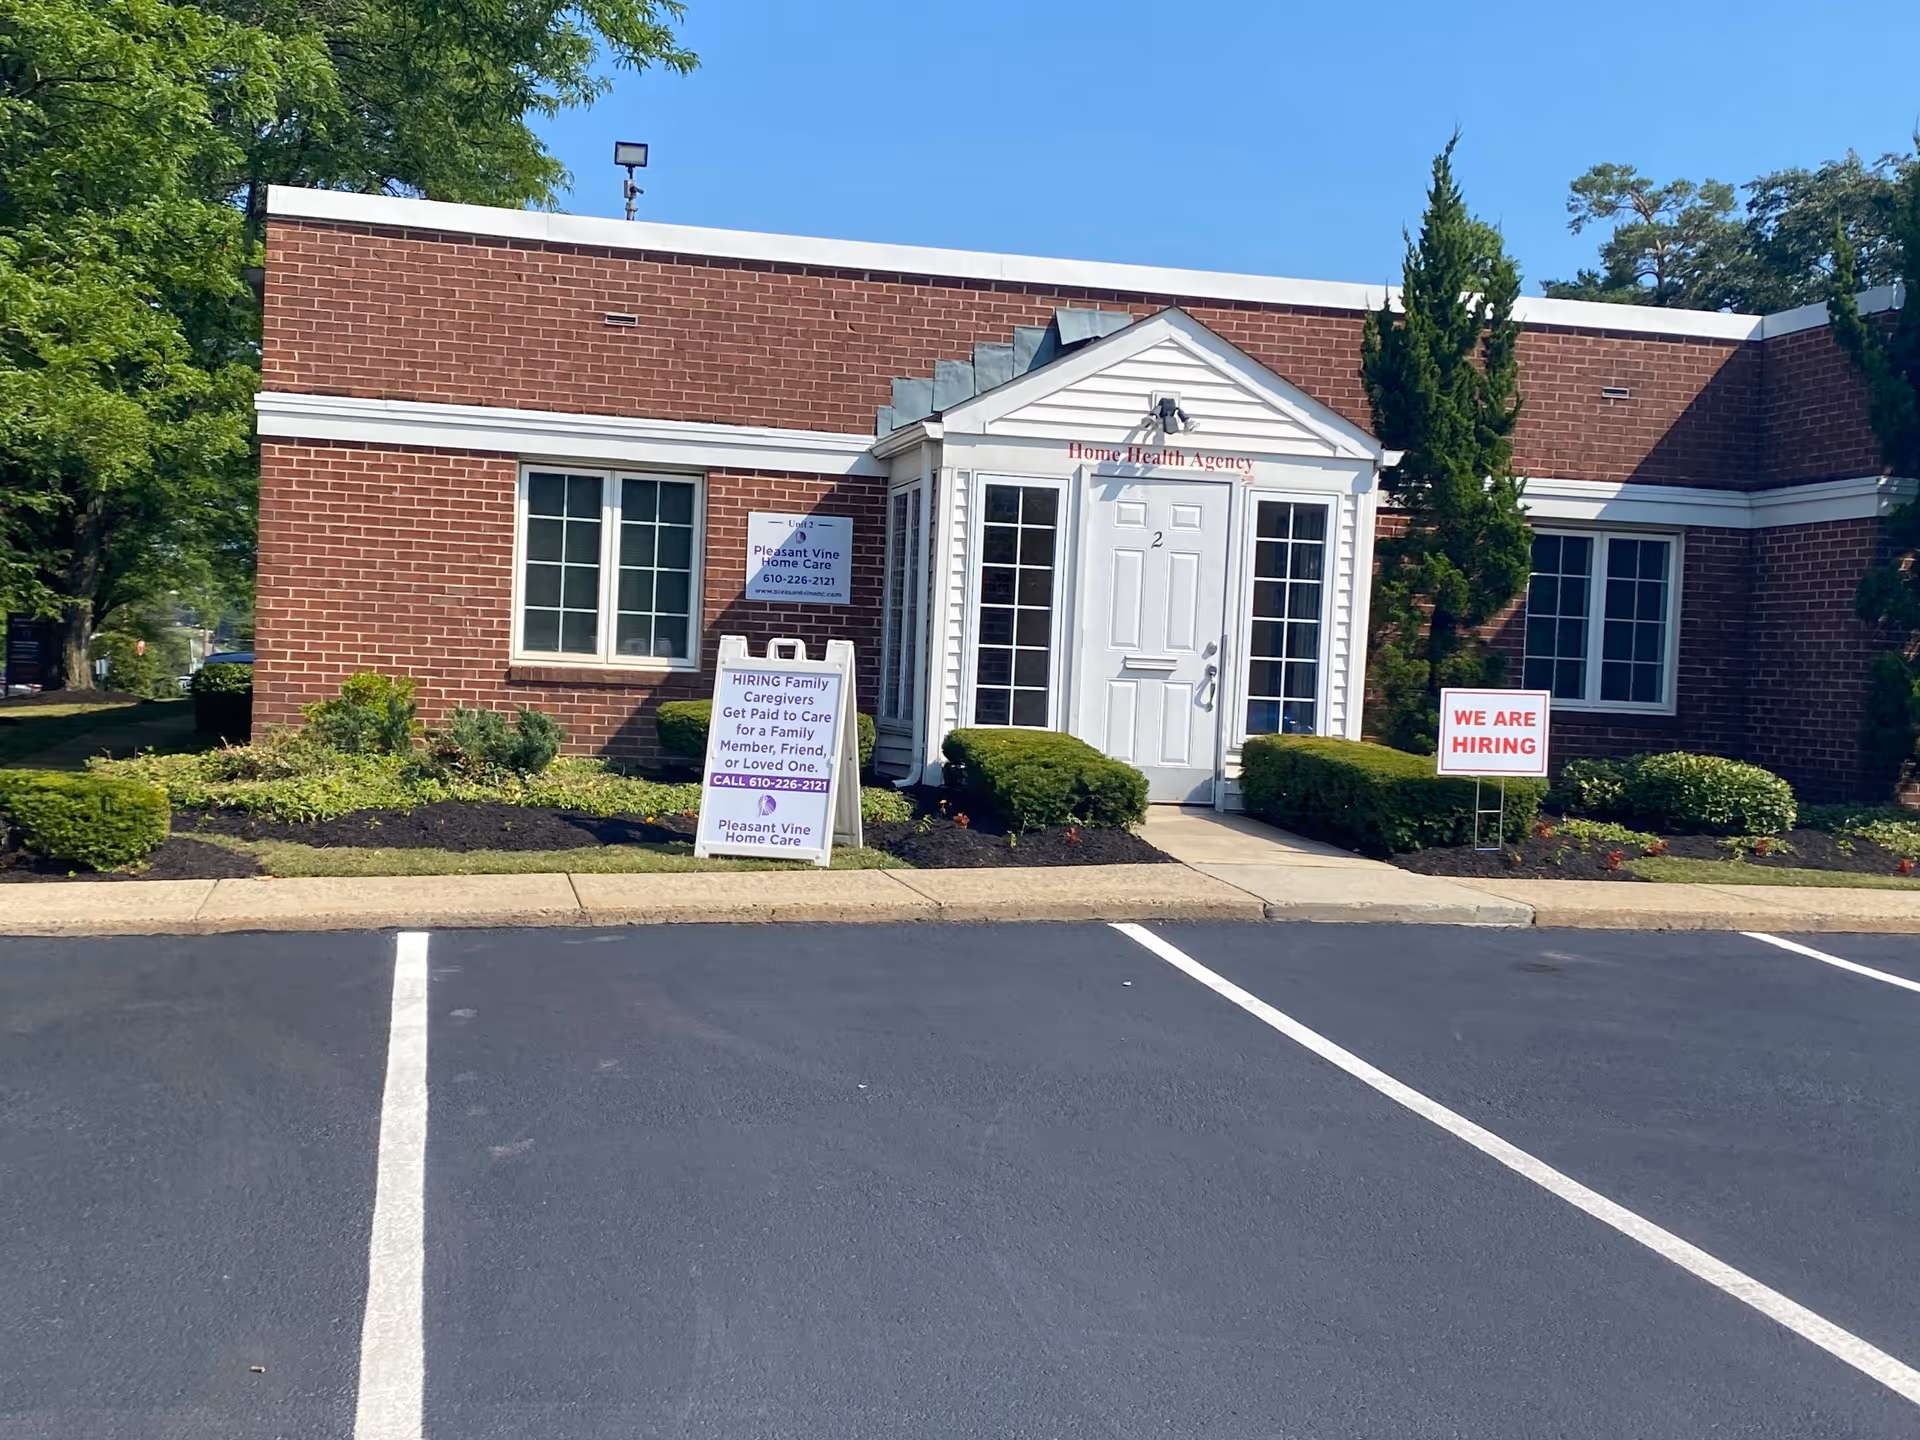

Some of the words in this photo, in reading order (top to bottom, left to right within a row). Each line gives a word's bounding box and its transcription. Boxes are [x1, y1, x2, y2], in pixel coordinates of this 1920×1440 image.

[1068, 442, 1121, 462] Home
[1127, 446, 1185, 466] Health
[1190, 453, 1254, 473] Agency
[789, 520, 807, 528] Unit
[1151, 531, 1163, 549] 2
[754, 545, 807, 558] Pleasant
[812, 549, 840, 559] Vine
[761, 557, 798, 568] Home
[803, 559, 831, 569] Care
[763, 574, 835, 585] 610-226-2121
[732, 674, 781, 687] HIRING
[785, 677, 829, 691] Family
[744, 692, 814, 705] Caregivers
[723, 707, 746, 718] Get
[751, 709, 779, 720] Paid
[784, 711, 797, 721] to
[801, 712, 831, 722] Care
[1454, 710, 1486, 725] WE
[1493, 711, 1536, 726] ARE
[736, 724, 755, 735] for
[759, 728, 766, 736] a
[771, 726, 815, 740] Family
[720, 740, 776, 755] Member,
[781, 744, 827, 758] Friend,
[1452, 736, 1536, 754] HIRING
[725, 759, 739, 768] or
[743, 759, 783, 771] Loved
[788, 761, 818, 773] One.
[713, 776, 746, 786] CALL
[750, 777, 827, 791] 610-226-2121
[719, 820, 776, 833] Pleasant
[781, 824, 810, 835] Vine
[726, 832, 765, 844] Home
[770, 835, 801, 846] Care
